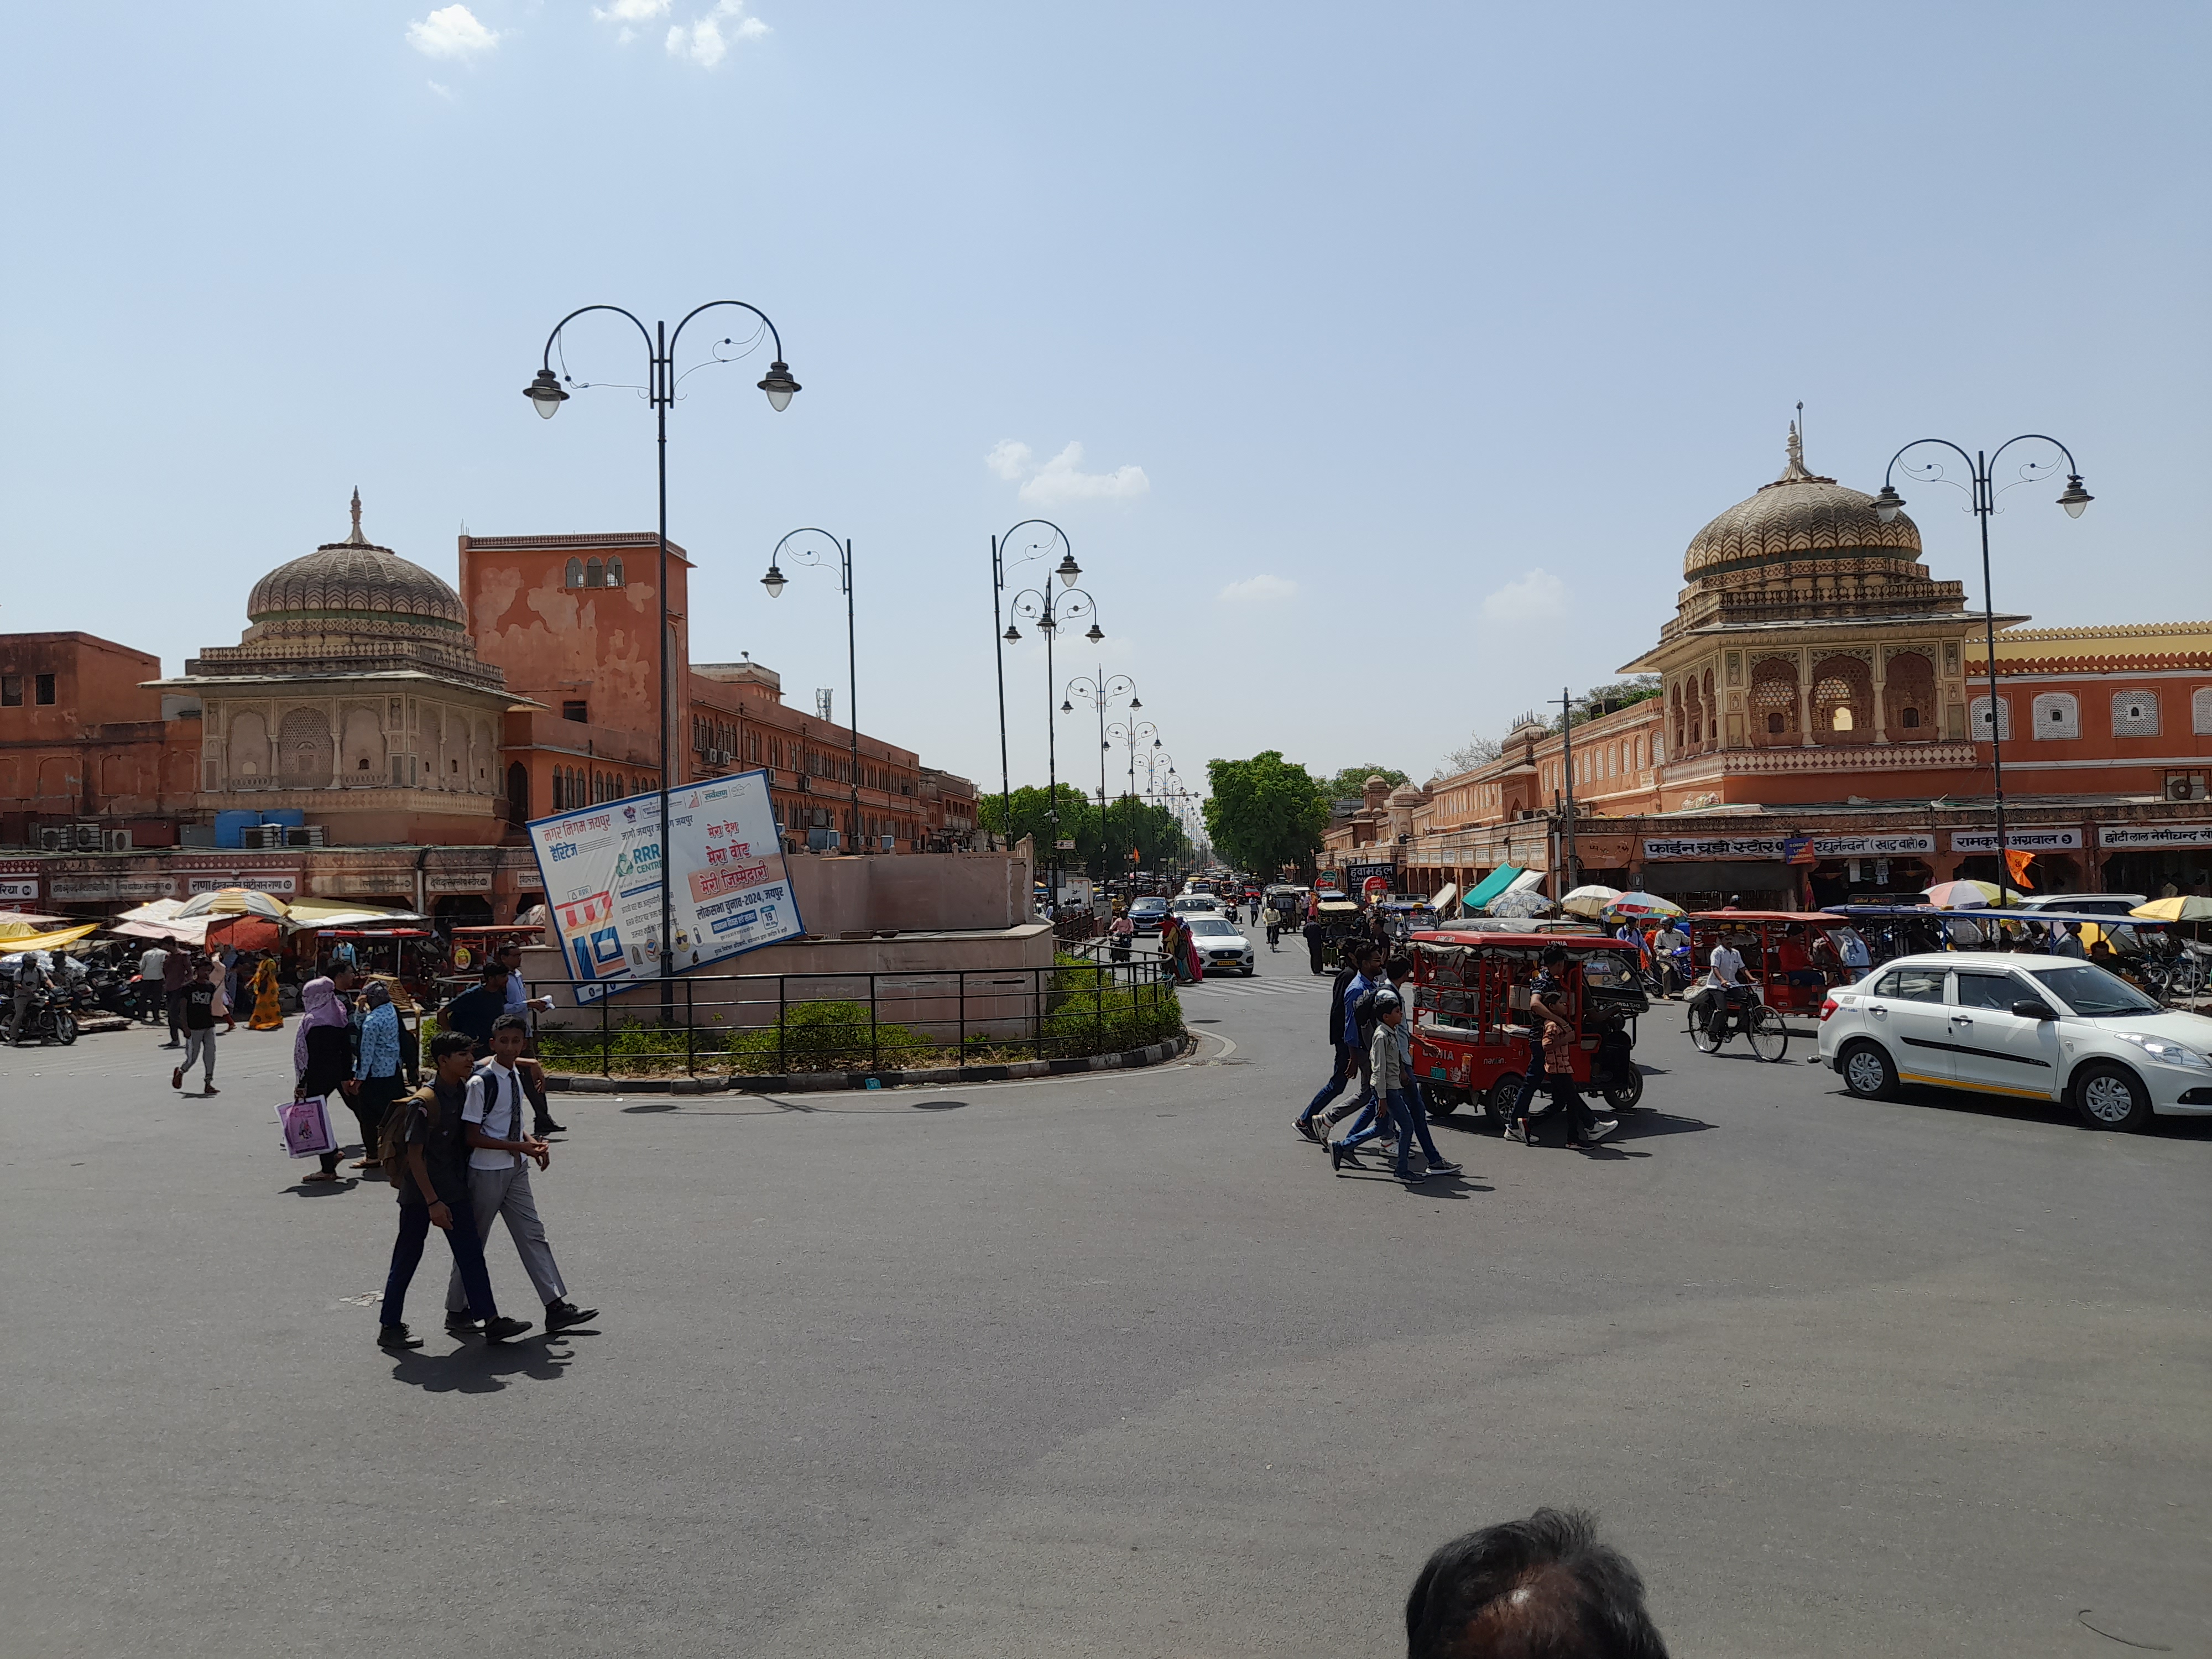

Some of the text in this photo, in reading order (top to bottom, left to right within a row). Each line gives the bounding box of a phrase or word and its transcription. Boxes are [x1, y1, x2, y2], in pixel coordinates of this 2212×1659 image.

[542, 814, 612, 842] नगर निगम जयपुर
[636, 825, 654, 837] जयपुर
[675, 815, 693, 827] जयपुर
[707, 820, 739, 838] मेरा देश
[2130, 832, 2150, 842] लाल
[2150, 829, 2199, 841] नेमीचन्द
[1733, 839, 1774, 853] स्टोर
[2010, 834, 2058, 845] अग्रवाल
[549, 842, 578, 862] हैरिटेज
[633, 843, 661, 864] RRR
[705, 839, 752, 865] मेरा वोट
[192, 880, 211, 891] राणा
[268, 880, 282, 890] राणा
[698, 859, 769, 895] मेरी जिम्मेदारी
[696, 902, 724, 920] लोकसभा
[725, 891, 764, 914] चुनाव-2024,
[763, 886, 784, 901] जयपुर
[765, 912, 773, 922] 19
